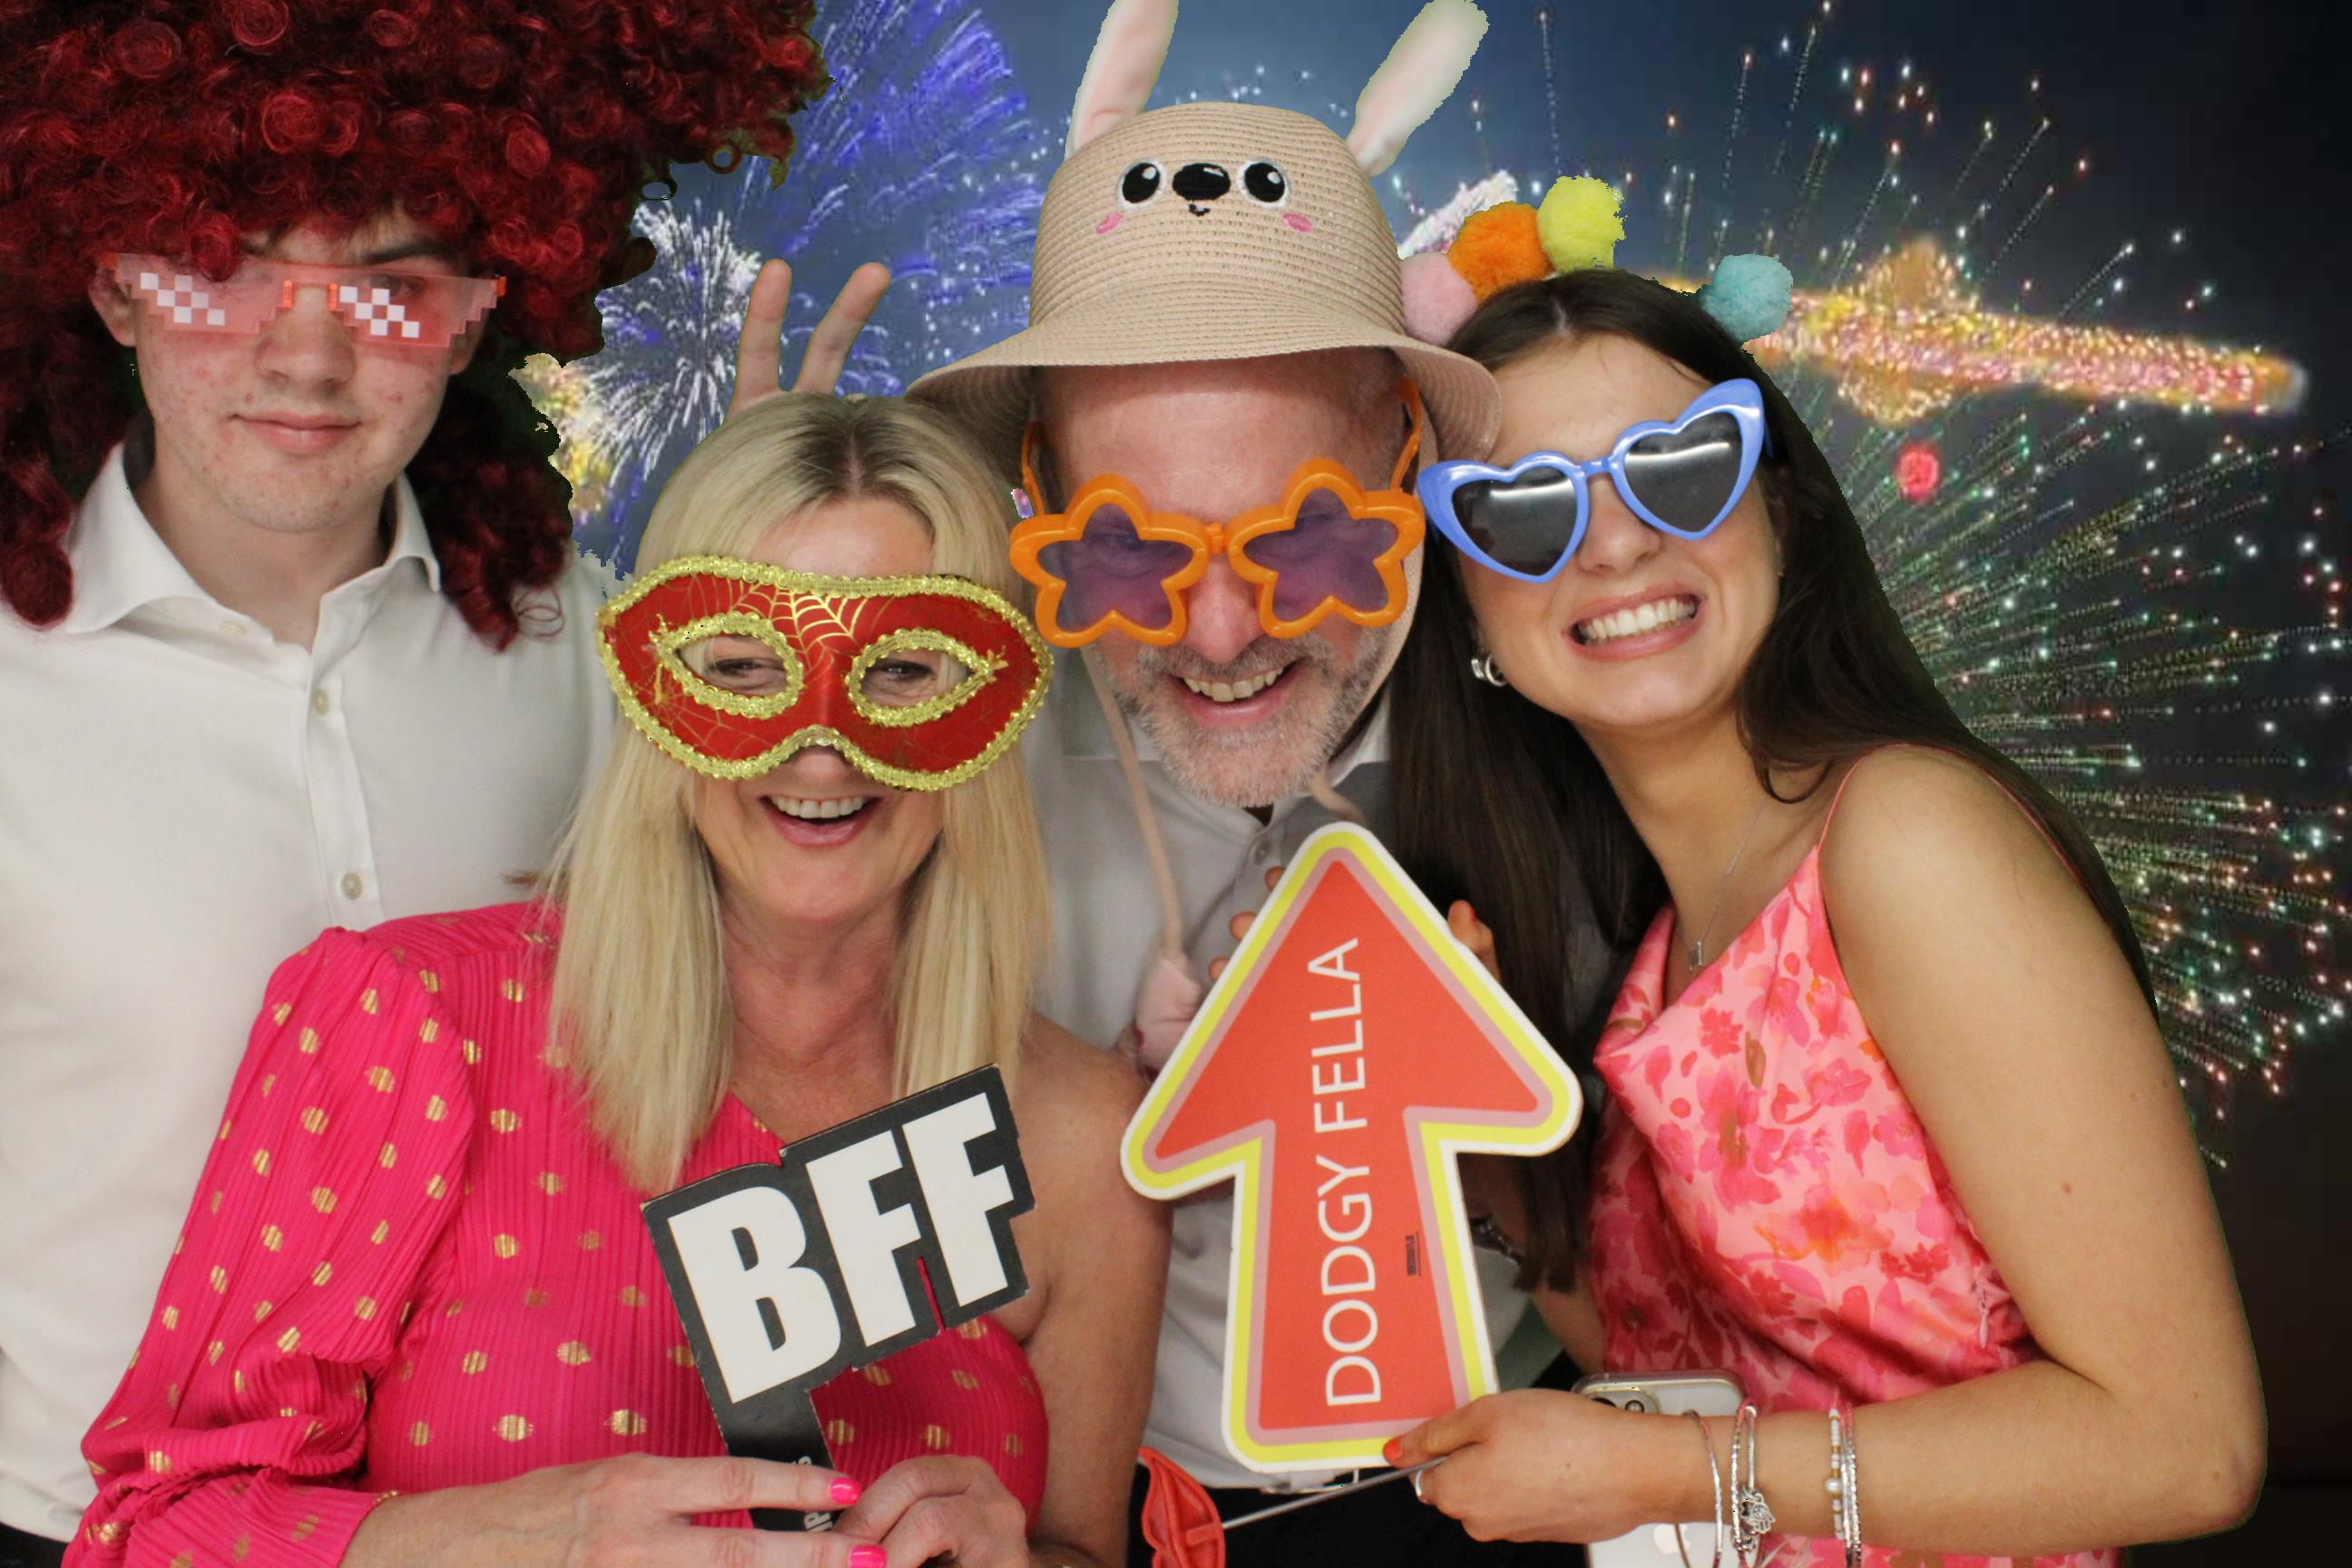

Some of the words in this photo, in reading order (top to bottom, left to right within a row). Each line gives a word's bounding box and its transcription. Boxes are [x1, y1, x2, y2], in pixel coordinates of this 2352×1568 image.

[1308, 938, 1367, 1132] FELLA
[667, 1093, 1014, 1404] BFF
[1317, 1155, 1381, 1406] DODGY
